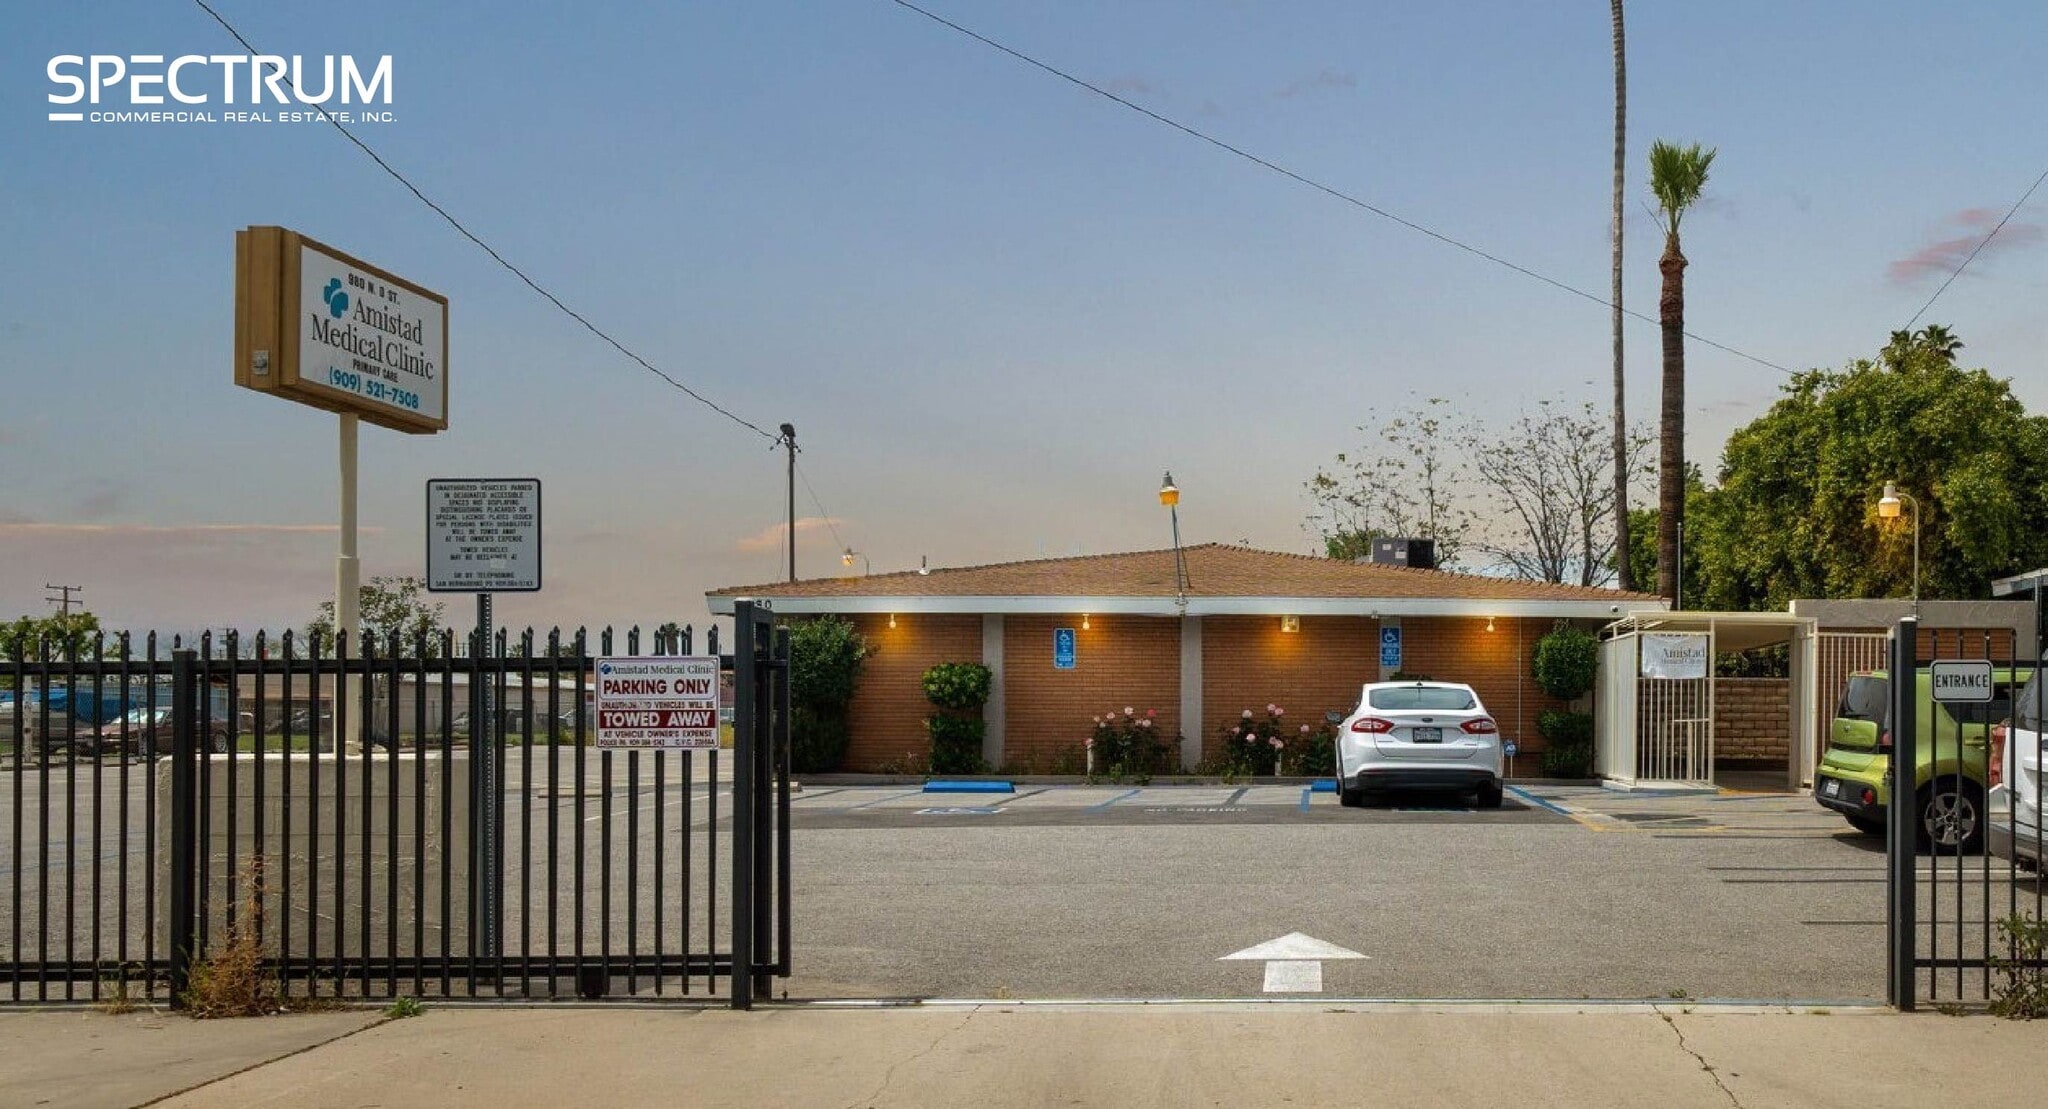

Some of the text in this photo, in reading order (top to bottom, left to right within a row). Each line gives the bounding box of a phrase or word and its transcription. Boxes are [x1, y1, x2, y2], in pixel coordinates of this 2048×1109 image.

[348, 273, 365, 290] 980
[388, 290, 400, 304] ST.
[353, 298, 422, 346] Amistad
[312, 314, 434, 380] Medical Clinic
[353, 360, 398, 382] PRIMARY CARE
[330, 366, 419, 408] (909) 521-7508
[1663, 647, 1705, 658] Amistad
[612, 665, 714, 675] Amistad Medical Clinic
[603, 679, 711, 694] PARKING ONLY
[1935, 674, 1989, 688] ENTRANCE
[604, 712, 711, 727] TOWED AWAY
